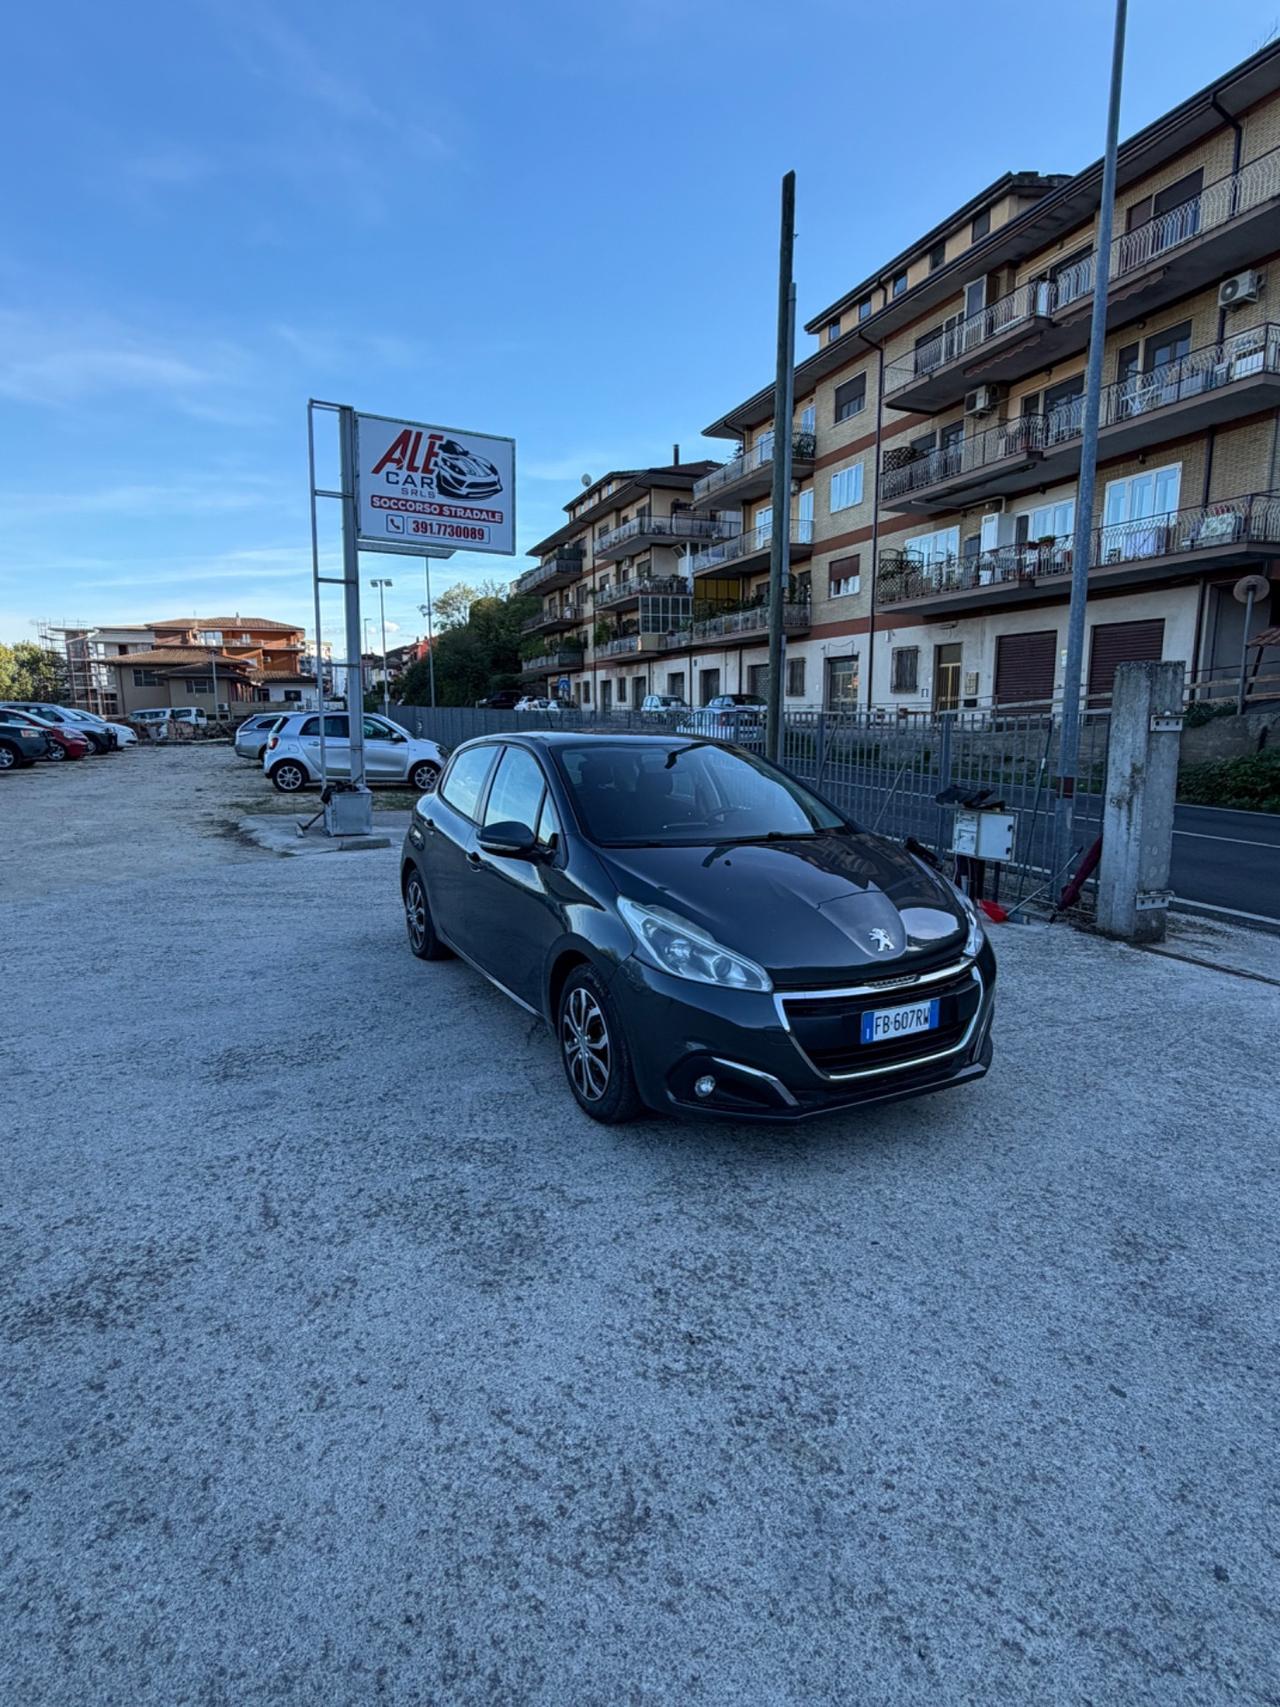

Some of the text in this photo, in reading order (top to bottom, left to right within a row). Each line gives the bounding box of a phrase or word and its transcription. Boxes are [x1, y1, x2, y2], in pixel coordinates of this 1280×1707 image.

[371, 429, 444, 475] ALE
[385, 471, 435, 489] CAR
[401, 488, 436, 499] SRLS
[372, 496, 503, 523] SOCCORSO STRADALE
[412, 520, 485, 541] 391.7730089
